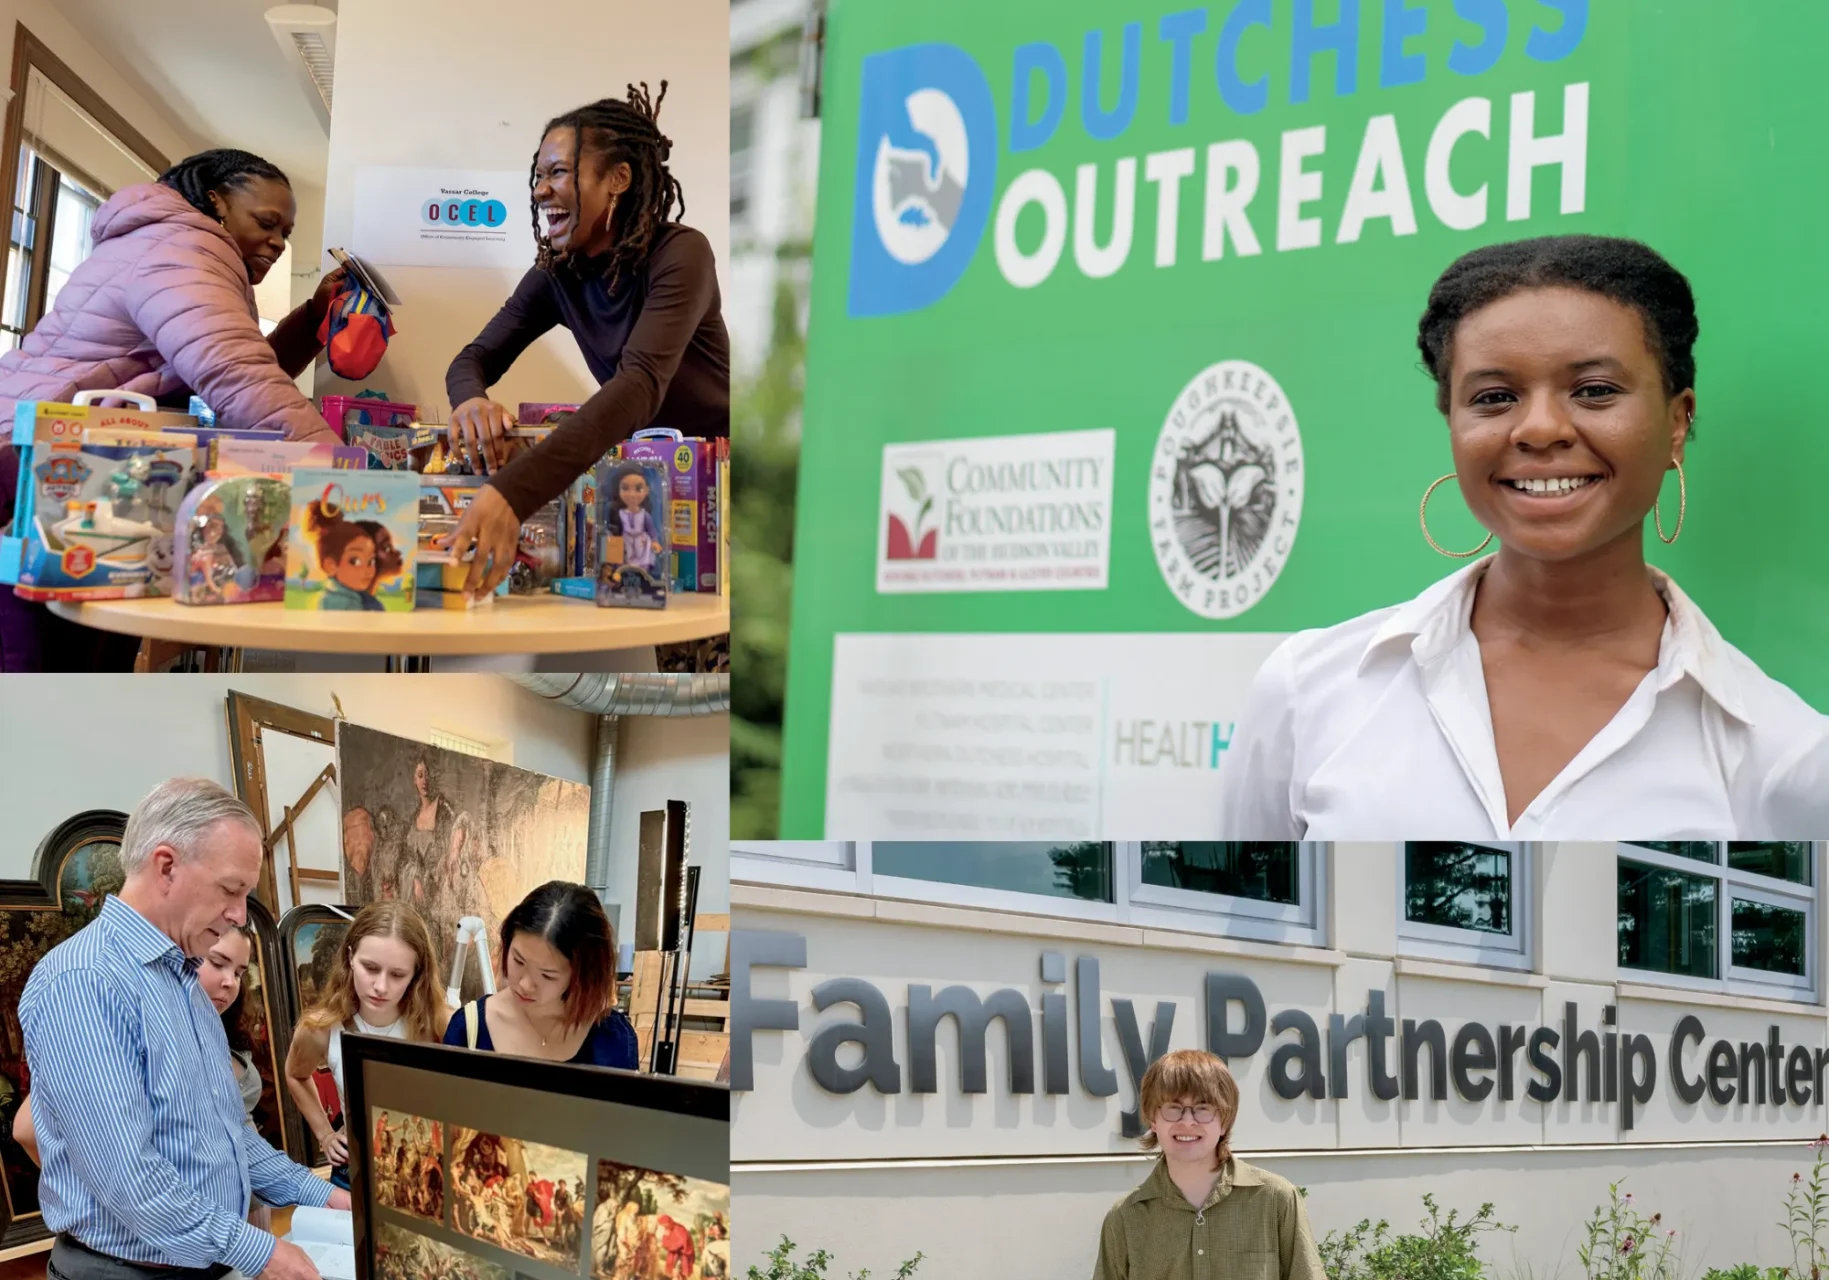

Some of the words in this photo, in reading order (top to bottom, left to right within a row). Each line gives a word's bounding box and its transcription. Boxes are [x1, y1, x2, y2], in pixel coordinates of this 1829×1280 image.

[1010, 0, 1589, 153] DUTCHESS
[994, 81, 1590, 288] OUTREACH
[428, 203, 496, 223] OCEL
[100, 418, 116, 428] ALL
[119, 417, 149, 429] ABOUT
[677, 452, 690, 463] 40
[946, 455, 1104, 495] COMMUNITY
[706, 486, 717, 543] MATCH
[945, 498, 1104, 537] FOUNDATIONS
[730, 930, 1177, 1138] Family
[1204, 970, 1657, 1131] Partnership
[1671, 1014, 1829, 1107] Center
